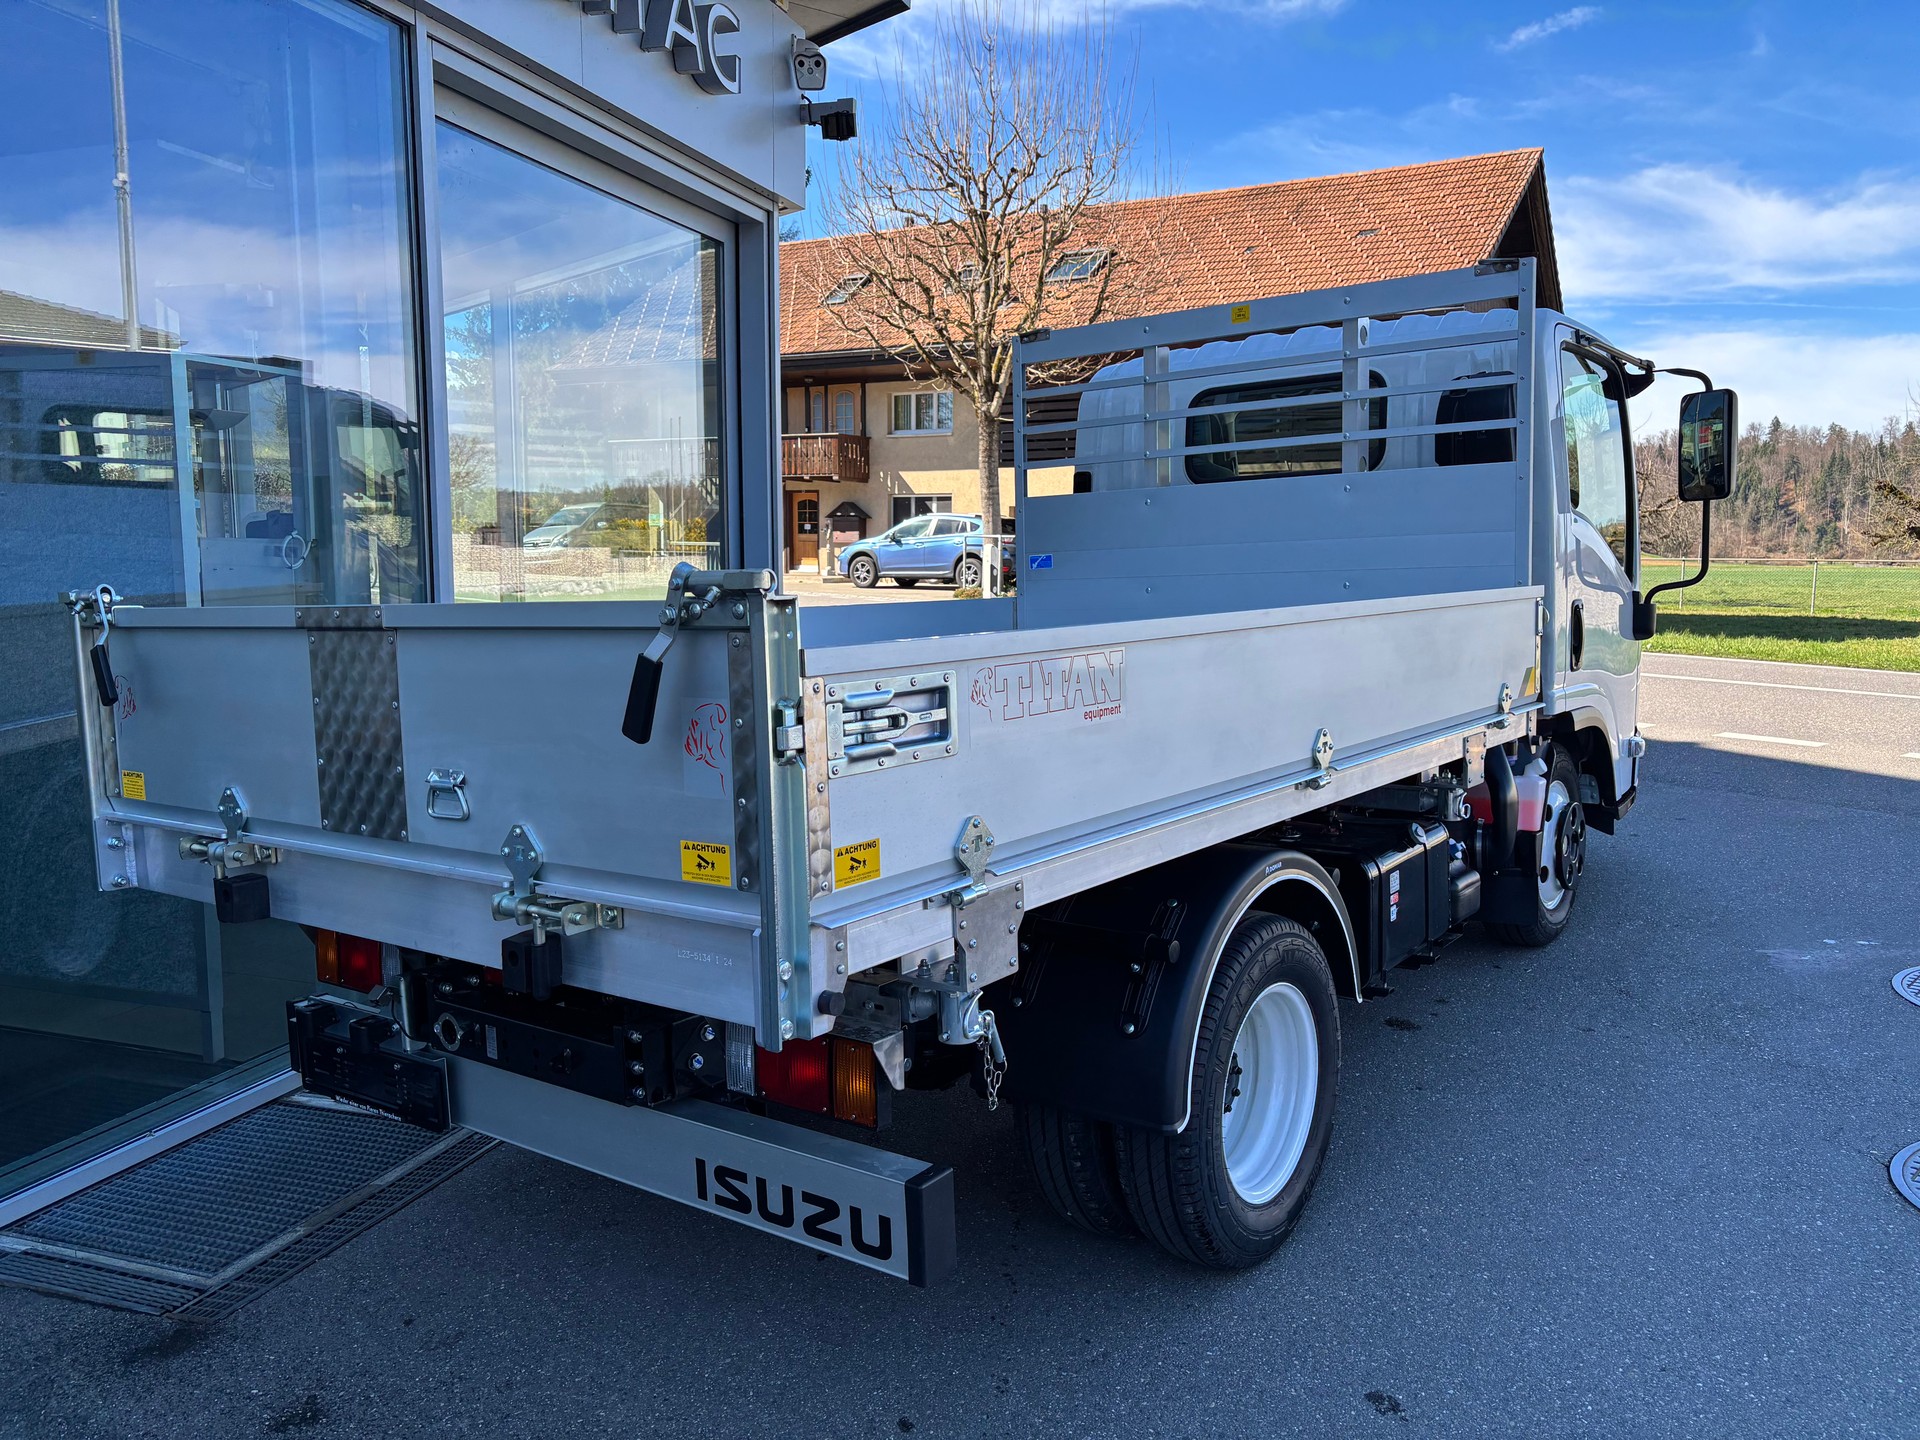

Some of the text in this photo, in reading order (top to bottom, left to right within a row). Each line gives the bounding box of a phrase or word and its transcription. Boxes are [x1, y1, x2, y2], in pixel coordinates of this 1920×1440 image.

[994, 650, 1124, 721] TITAN
[1083, 703, 1122, 721] equipment
[691, 843, 727, 855] ACHTUNG
[844, 840, 877, 856] ACHTUNG
[695, 1157, 893, 1261] ISUZU
